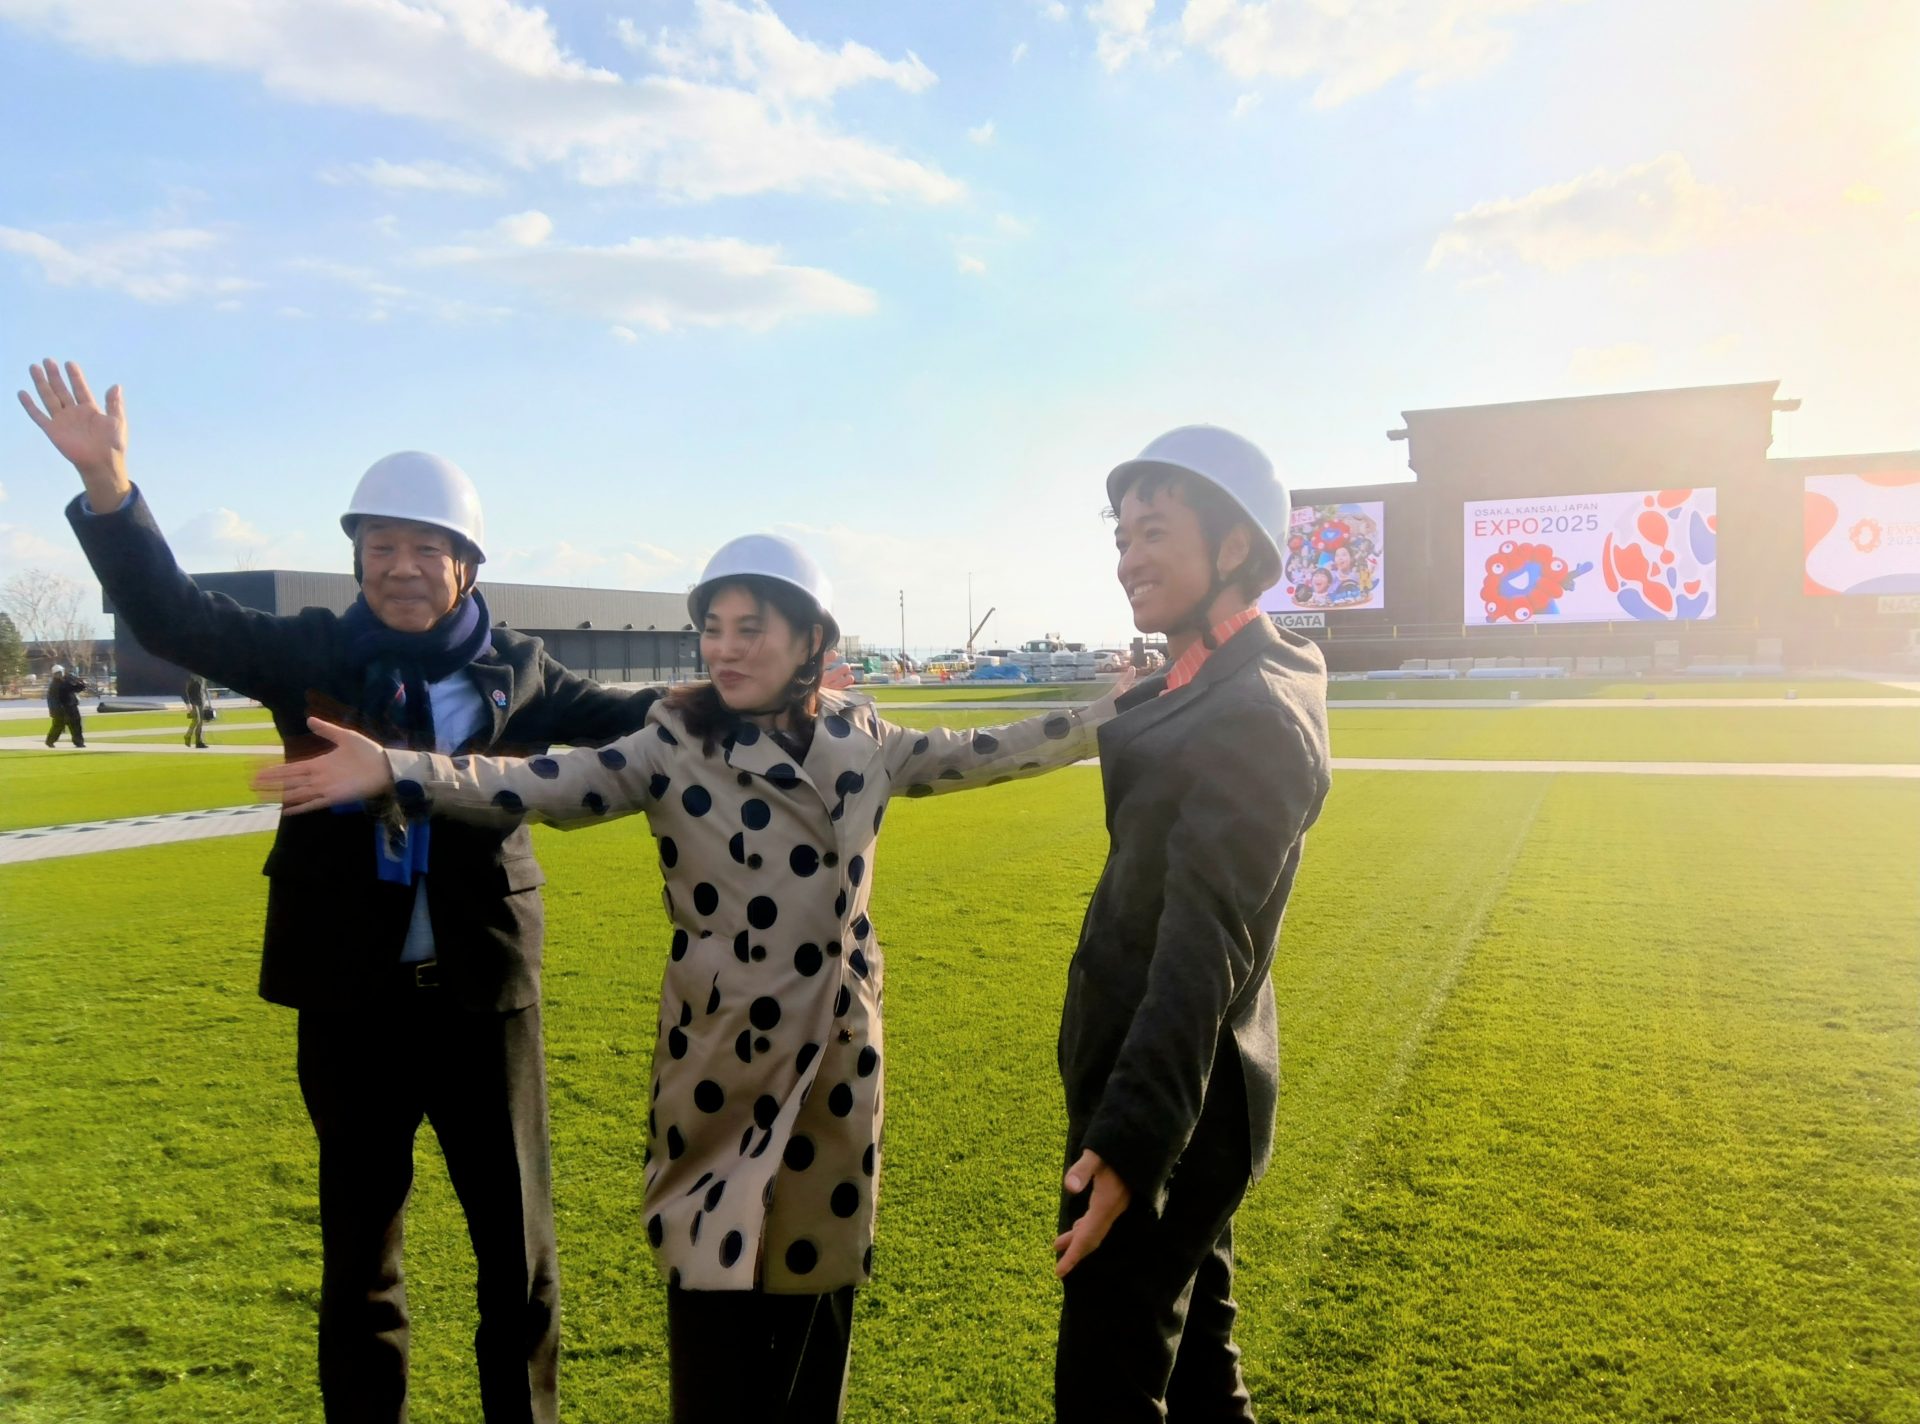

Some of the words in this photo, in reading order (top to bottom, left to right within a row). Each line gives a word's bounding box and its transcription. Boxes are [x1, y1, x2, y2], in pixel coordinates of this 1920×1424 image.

[1474, 507, 1514, 517] OSAKA,
[1562, 502, 1599, 512] JAPAN
[1474, 514, 1599, 537] EXPO2025
[1270, 615, 1323, 627] AGATA
